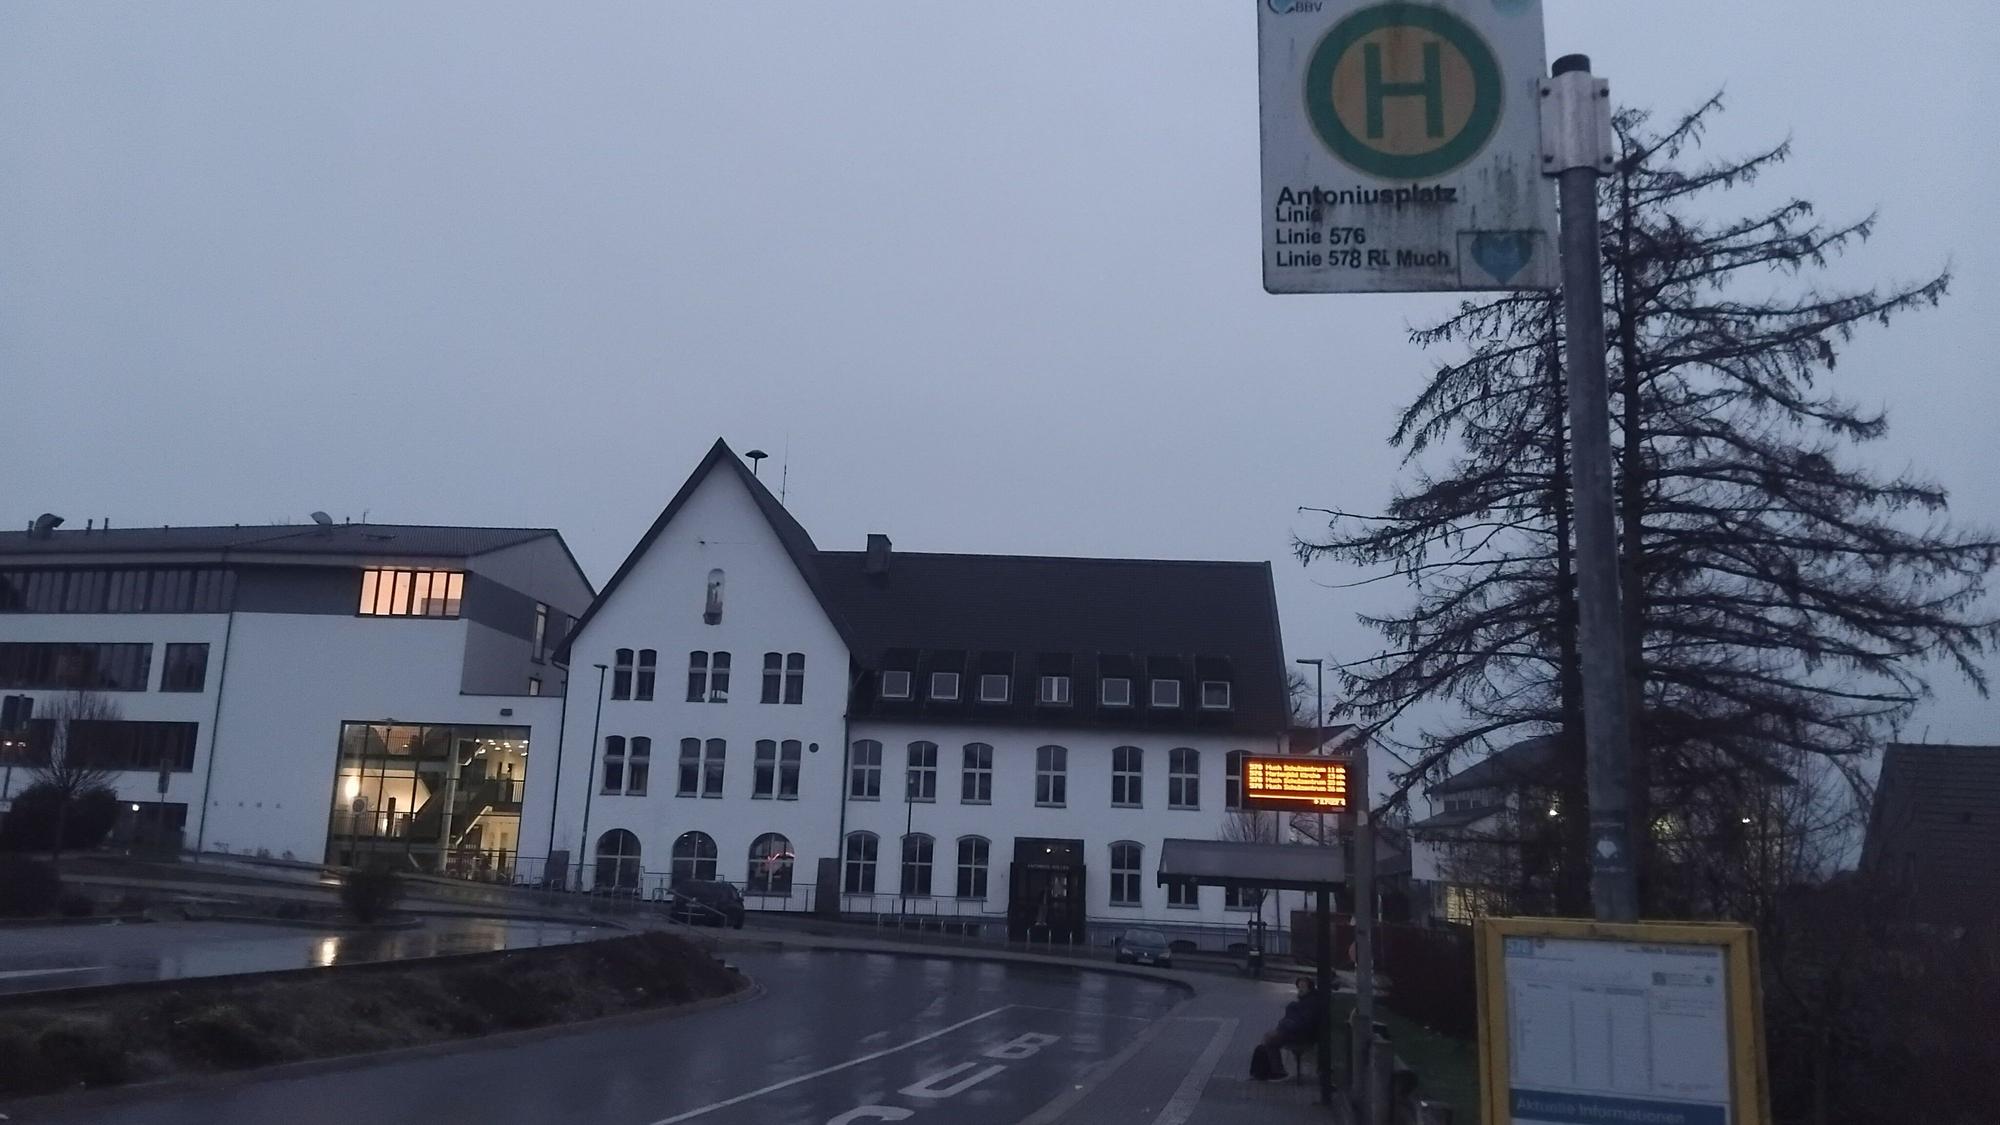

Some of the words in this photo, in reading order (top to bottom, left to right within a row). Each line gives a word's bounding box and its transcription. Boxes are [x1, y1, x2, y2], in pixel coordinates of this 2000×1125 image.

[1364, 42, 1443, 139] H
[1277, 184, 1458, 211] Antoniusplatz
[1276, 207, 1322, 223] Linie
[1276, 228, 1322, 245] Linie
[1329, 227, 1366, 245] 576
[1276, 250, 1322, 267] Linie
[1329, 249, 1361, 268] 578
[1396, 249, 1450, 267] Much
